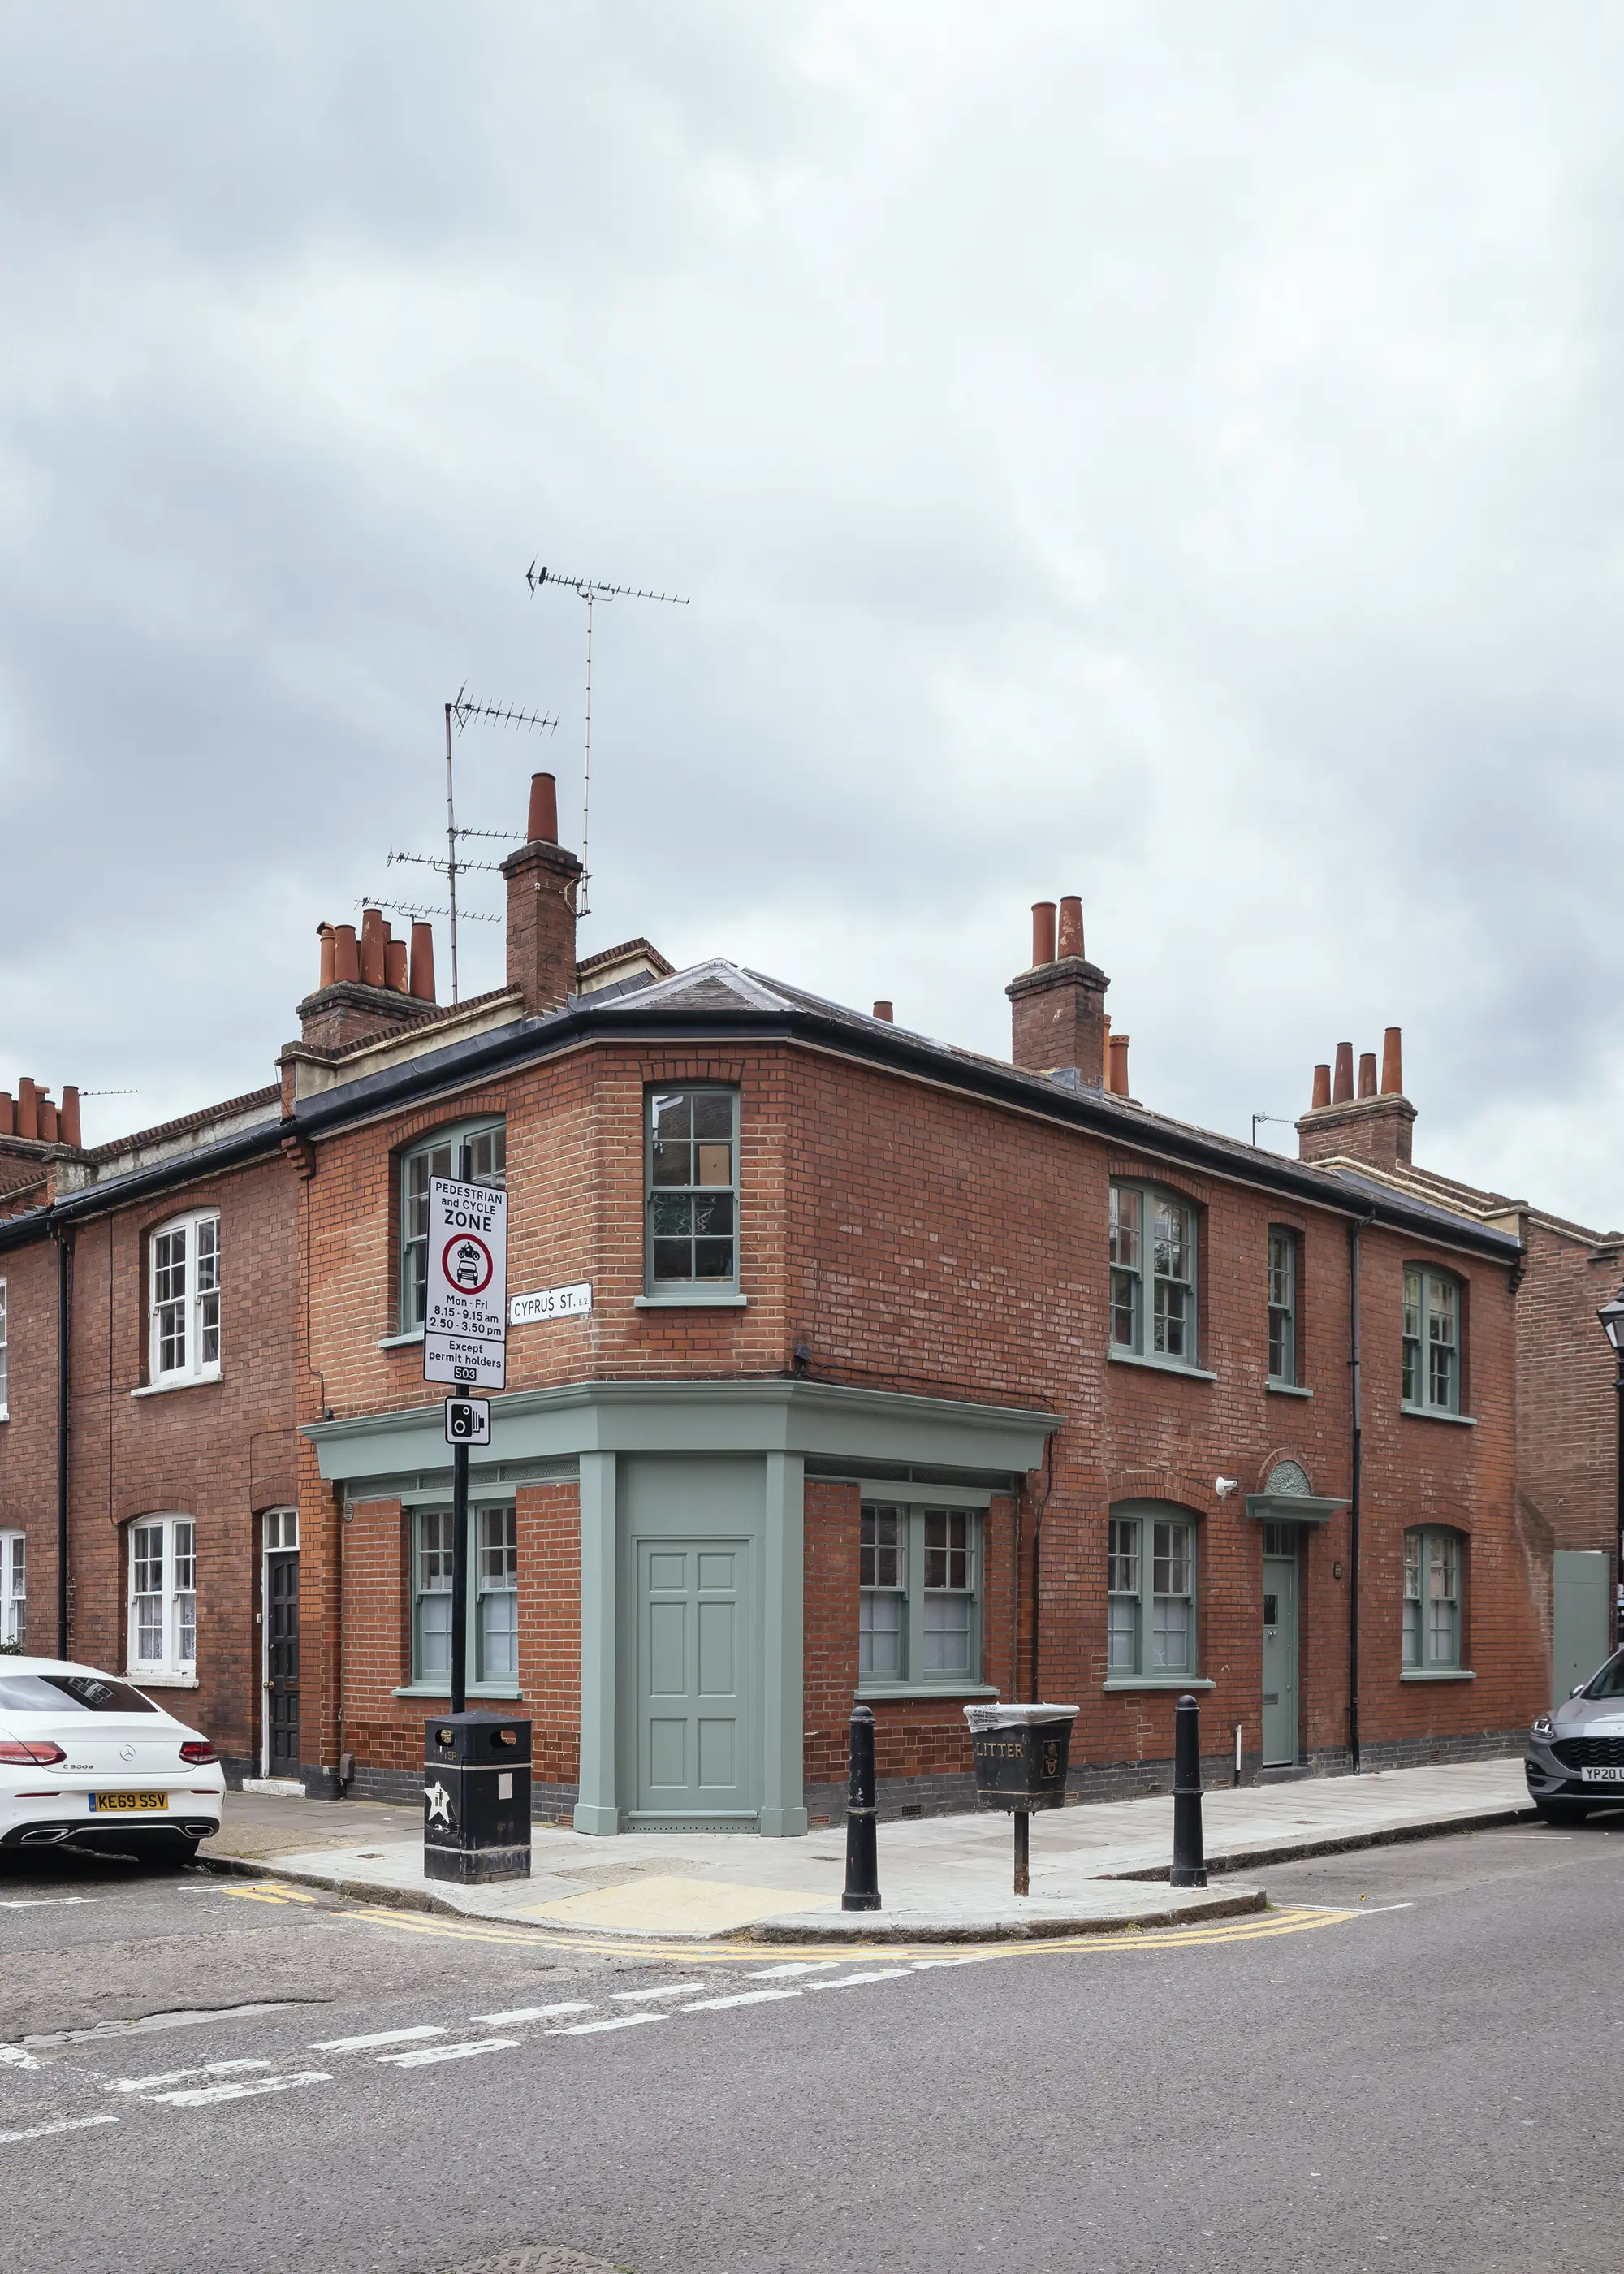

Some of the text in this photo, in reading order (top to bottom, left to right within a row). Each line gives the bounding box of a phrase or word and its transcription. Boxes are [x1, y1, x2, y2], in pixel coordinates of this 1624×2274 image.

[435, 1182, 502, 1204] PEDESTRIAN
[441, 1197, 496, 1215] and CYCLE
[444, 1208, 492, 1232] ZONE
[446, 1295, 467, 1307] Mon
[475, 1299, 488, 1310] Fri
[514, 1296, 555, 1317] CYPRUS
[559, 1293, 576, 1309] ST.
[434, 1305, 455, 1317] 8.15
[462, 1309, 482, 1321] 9.15
[485, 1315, 499, 1324] am
[430, 1316, 454, 1329] 2.50
[461, 1321, 485, 1334] 3.50
[486, 1327, 502, 1336] pm
[449, 1340, 483, 1354] Except
[429, 1352, 502, 1368] permit holders
[976, 1742, 1024, 1758] LITTER
[1586, 1769, 1616, 1779] YP20
[98, 1794, 166, 1809] KE69 SSV
